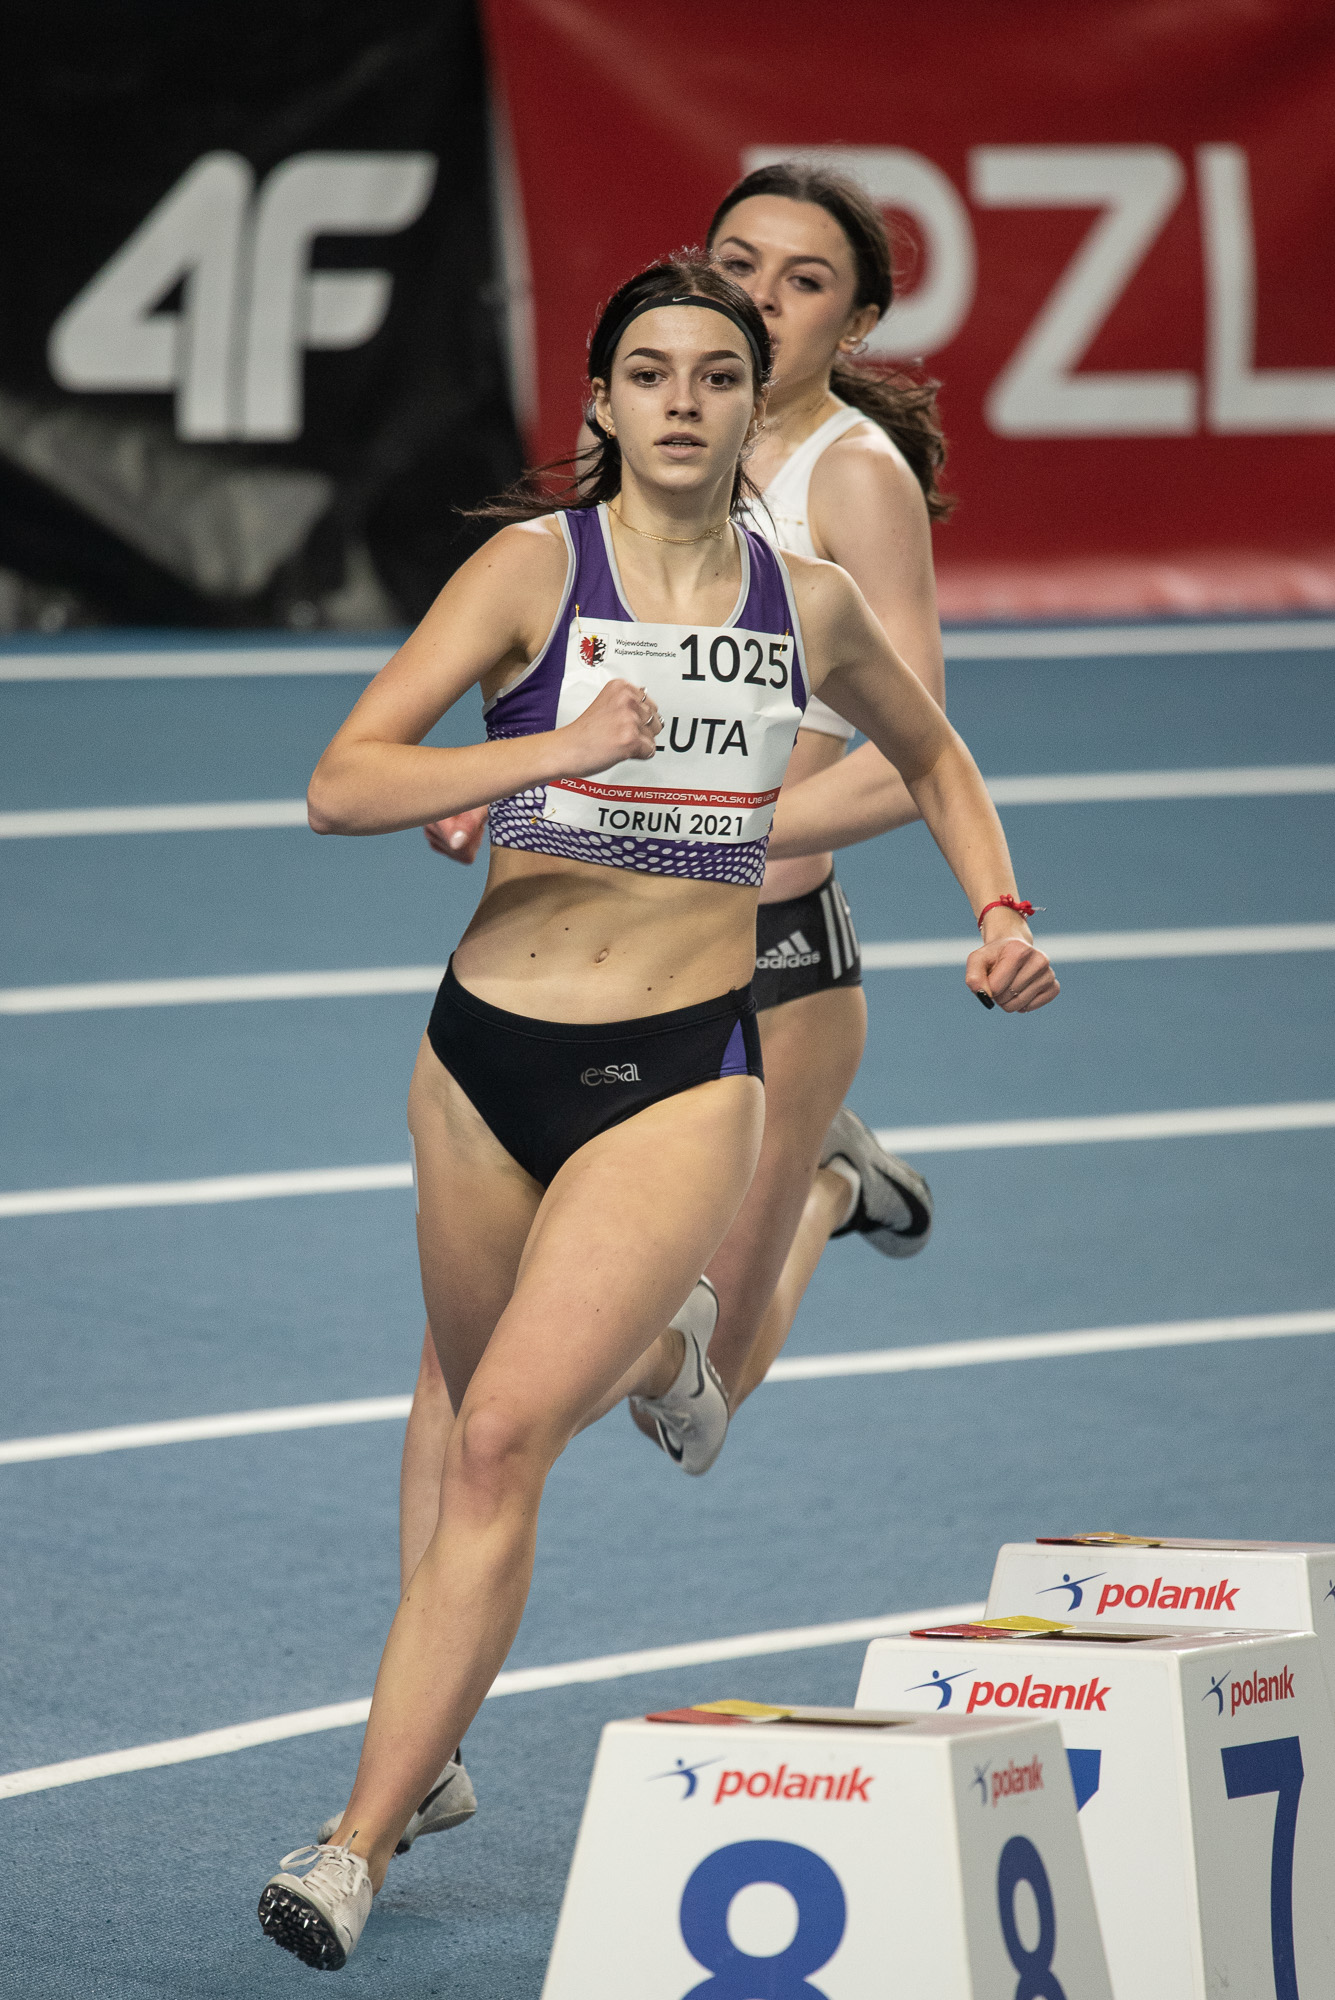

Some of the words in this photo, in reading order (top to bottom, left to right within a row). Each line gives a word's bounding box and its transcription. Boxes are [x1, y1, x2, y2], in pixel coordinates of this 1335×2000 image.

[47, 149, 439, 443] 4F
[614, 648, 677, 658] Kujawsko-Pomorskie
[615, 638, 658, 648] Województwo
[680, 633, 789, 690] 1025
[655, 716, 749, 756] UTA
[560, 778, 587, 791] PZLA
[588, 786, 632, 798] HALOWE
[633, 791, 708, 802] MISTRZOSTWA
[709, 794, 746, 804] POLSKI
[598, 806, 682, 833] TORUŃ
[689, 813, 743, 837] 2021
[756, 950, 820, 969] adidas
[580, 1063, 642, 1087] esa
[1096, 1577, 1241, 1616] polanik
[965, 1674, 1112, 1714] polanik
[1231, 1664, 1296, 1718] polanik
[713, 1763, 876, 1806] polanik
[1220, 1736, 1304, 2000] 7
